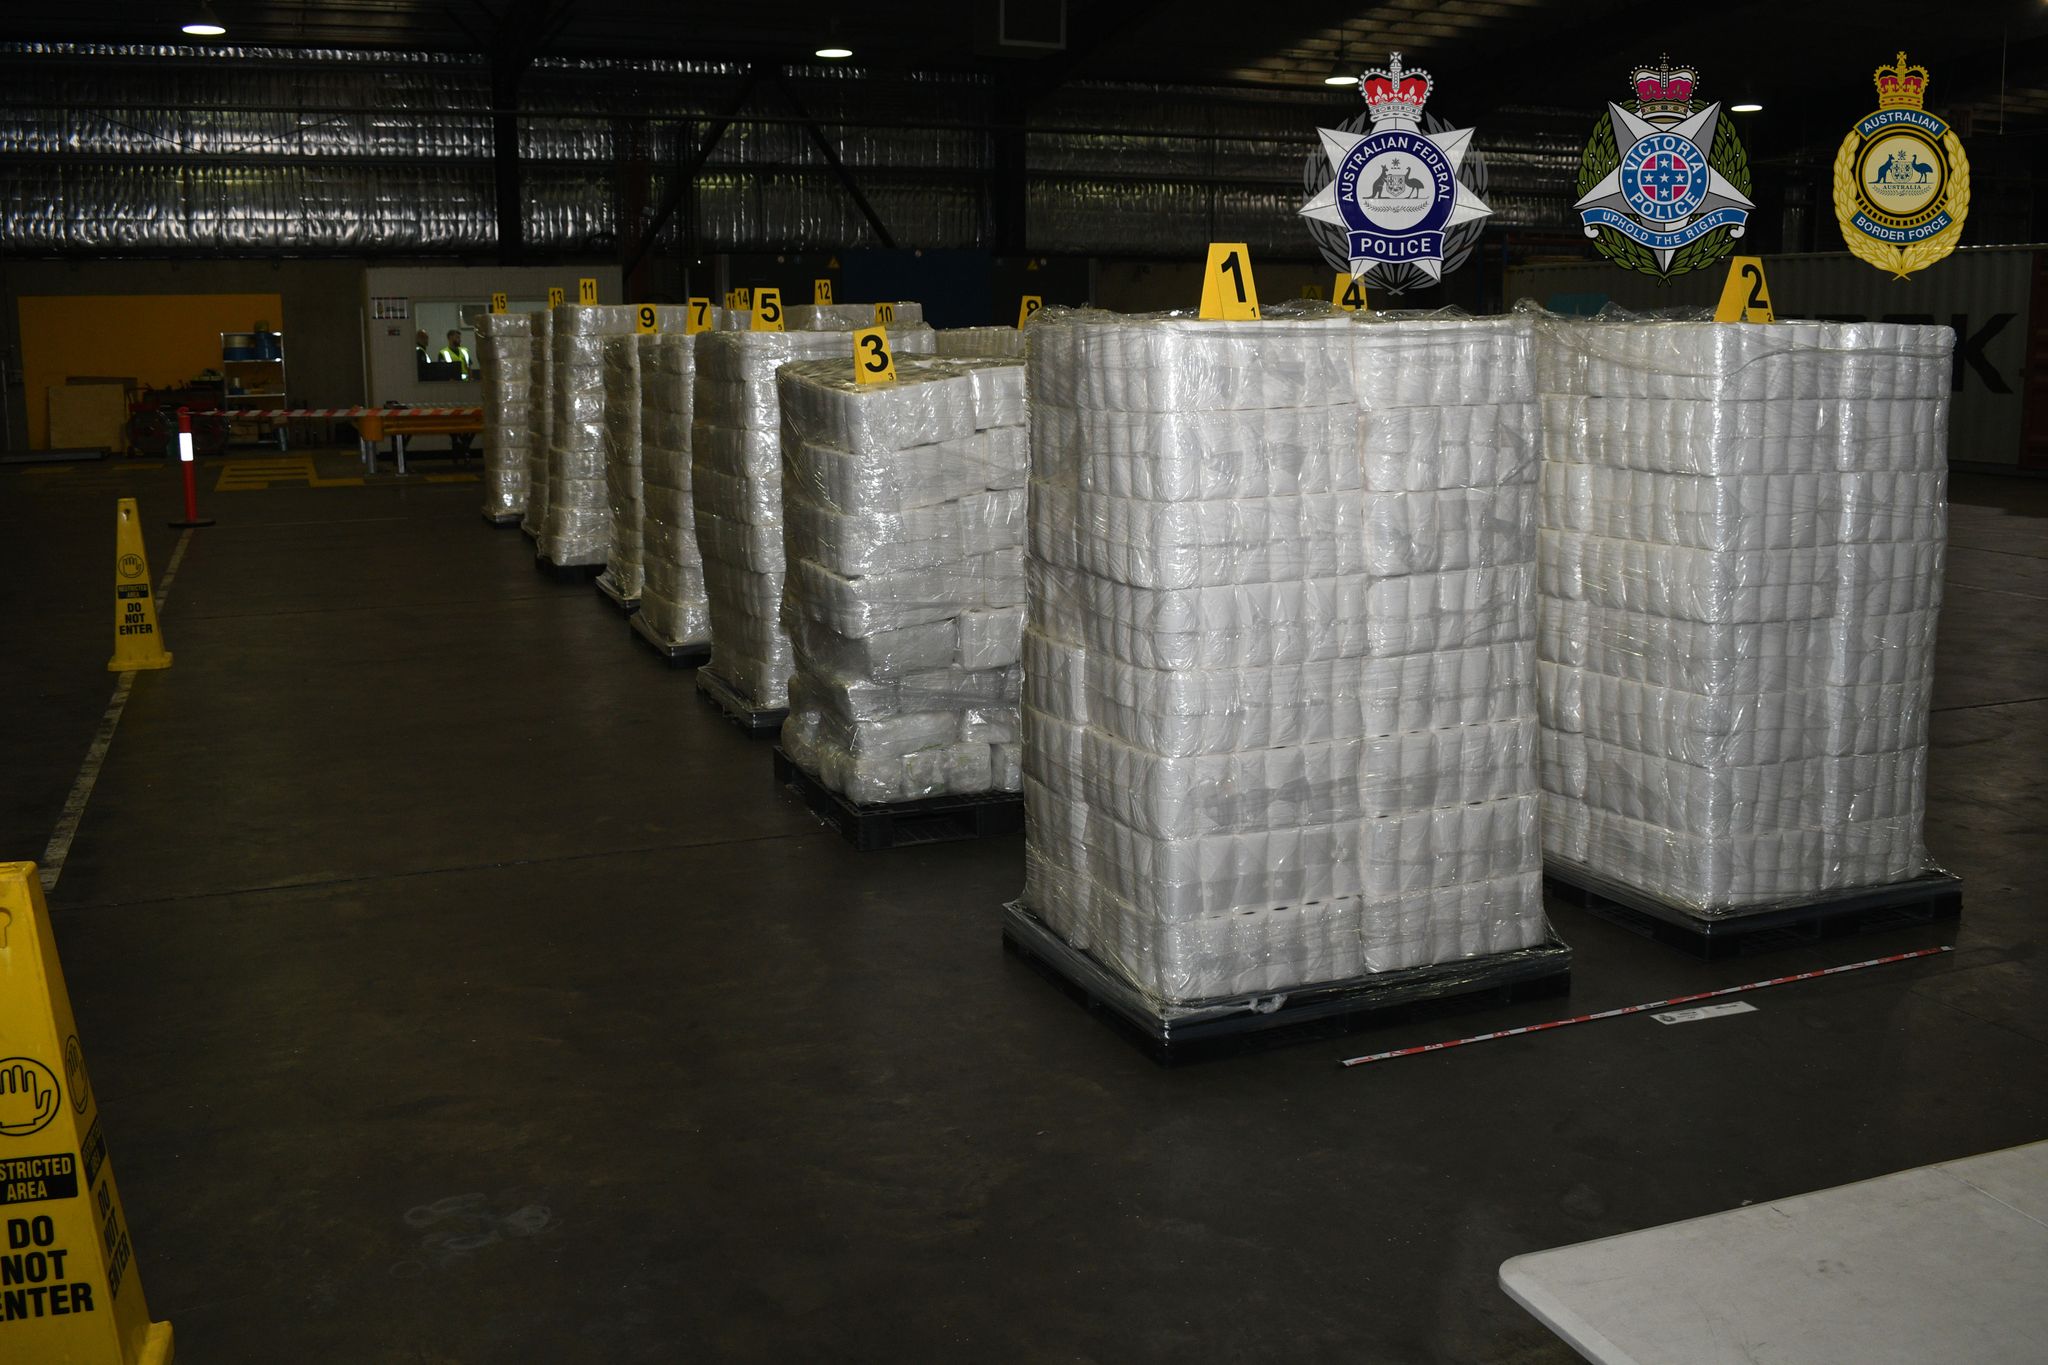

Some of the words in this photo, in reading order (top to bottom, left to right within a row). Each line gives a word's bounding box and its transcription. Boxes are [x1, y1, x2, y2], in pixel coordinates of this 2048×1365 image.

[1221, 251, 1247, 303] 1
[1741, 263, 1769, 309] 2
[551, 291, 563, 308] 13
[583, 281, 594, 300] 11
[737, 290, 748, 306] 14
[817, 282, 831, 300] 12
[1342, 280, 1364, 310] 4
[495, 295, 506, 310] 15
[761, 293, 780, 323] 5
[641, 307, 655, 328] 9
[692, 302, 708, 326] 7
[878, 306, 893, 323] 10
[1251, 307, 1256, 318] 1
[1766, 312, 1772, 322] 2
[860, 334, 889, 373] 3
[888, 373, 894, 381] 3
[127, 602, 142, 613] DO
[125, 613, 145, 624] NOT
[119, 624, 153, 635] ENTER
[7, 1180, 48, 1202] AREA
[8, 1215, 54, 1249] DO
[1, 1249, 68, 1286] NOT
[0, 1282, 95, 1322] NTER
